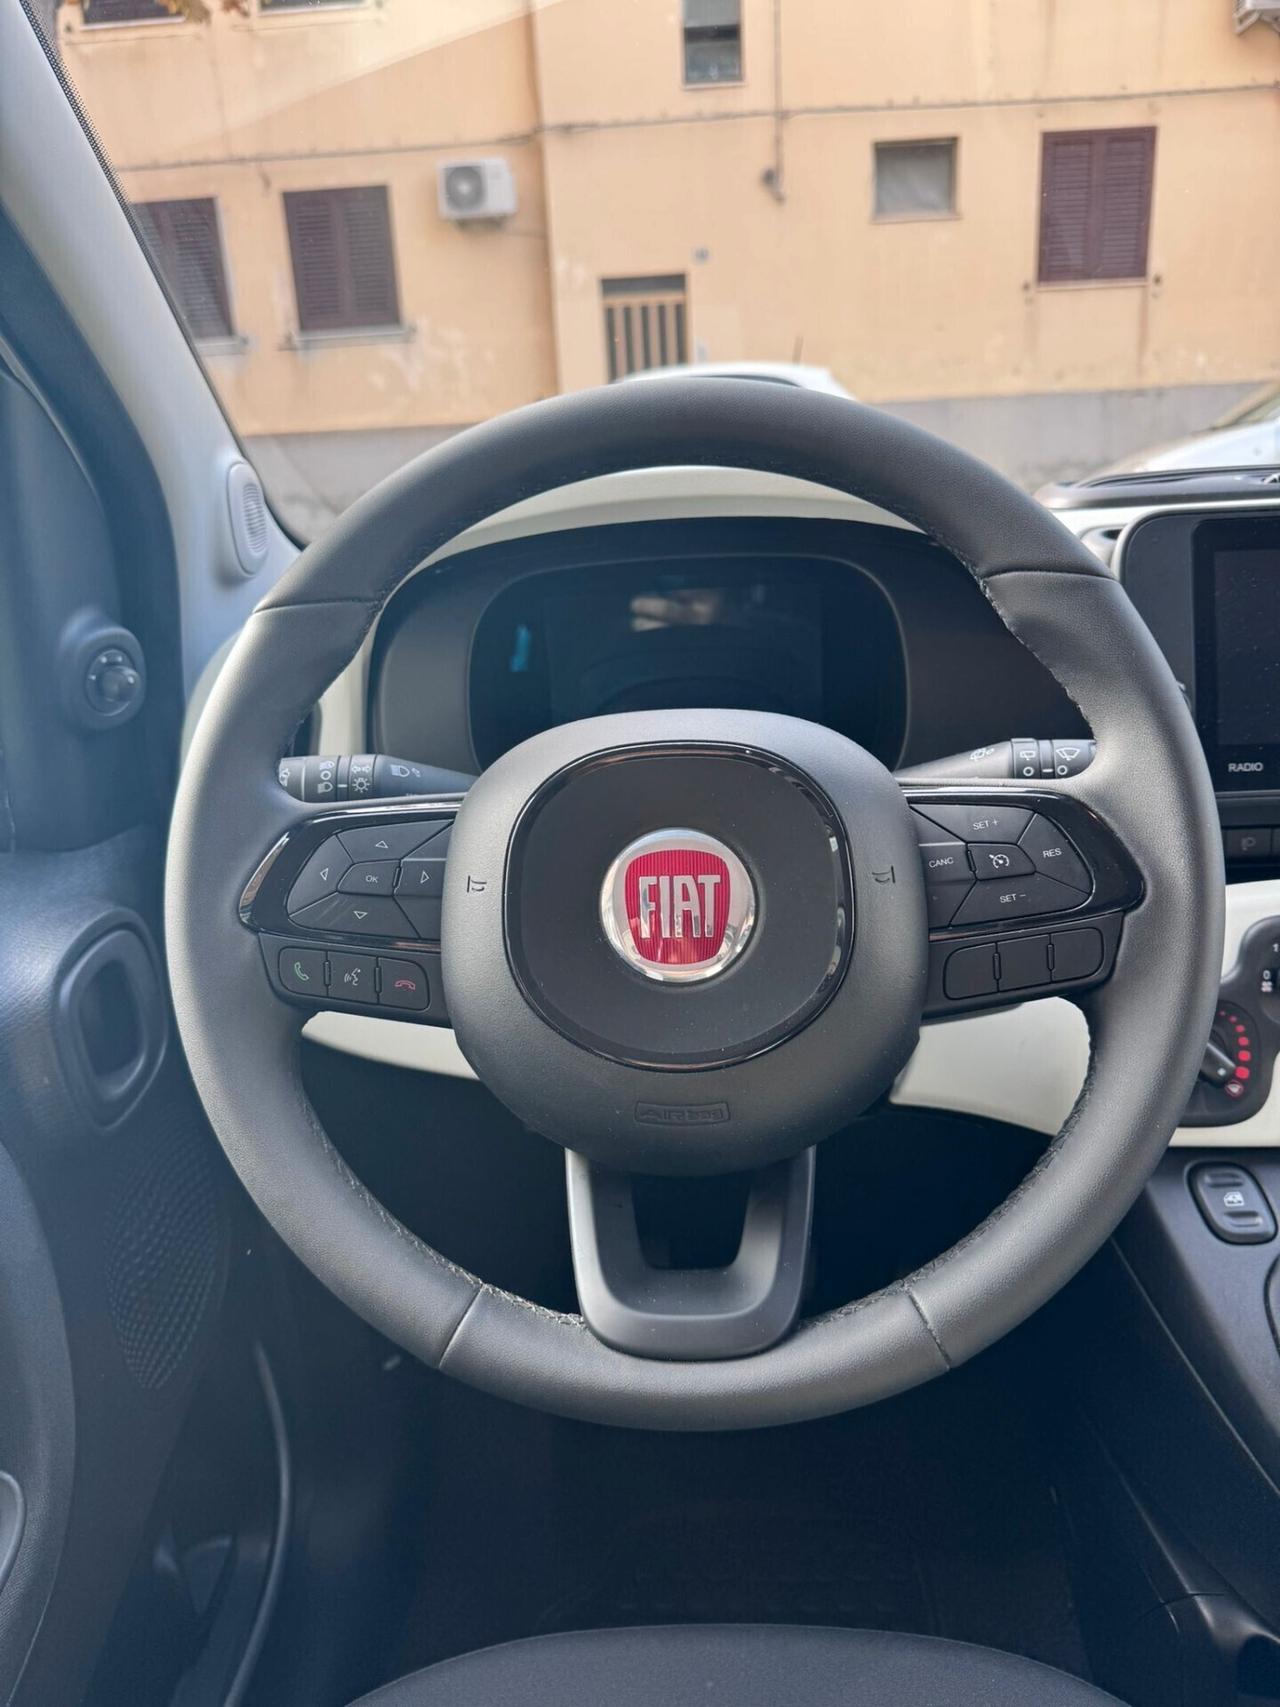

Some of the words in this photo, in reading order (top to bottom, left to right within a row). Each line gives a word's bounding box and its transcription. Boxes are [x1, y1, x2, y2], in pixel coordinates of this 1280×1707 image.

[1228, 762, 1264, 772] RADIO
[973, 820, 990, 830] SET
[1042, 847, 1062, 858] RES
[929, 857, 954, 868] CANC
[366, 874, 378, 883] OK
[1000, 893, 1017, 903] SET
[639, 875, 721, 938] FIAT
[1272, 943, 1279, 952] 1
